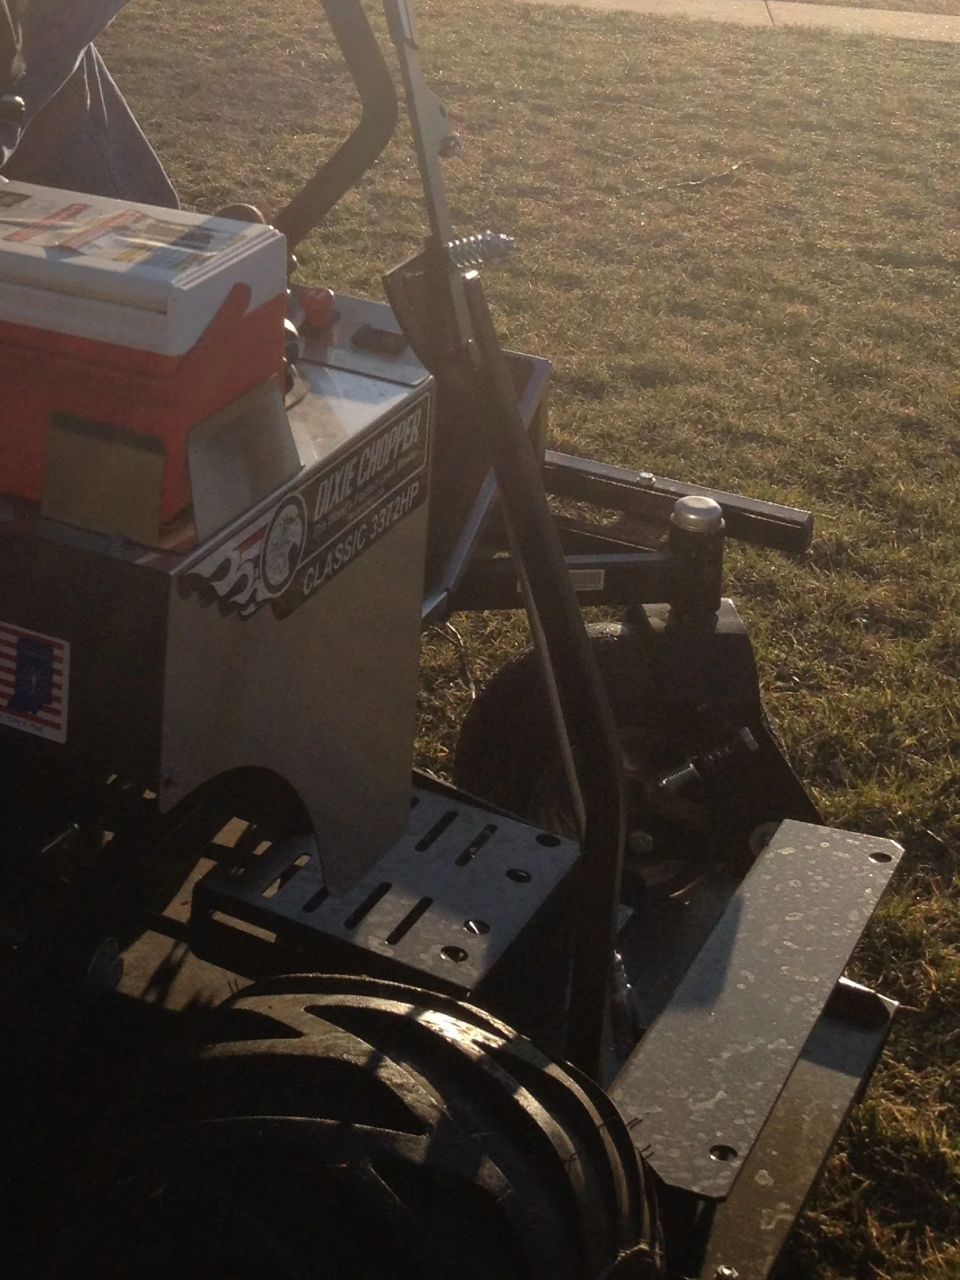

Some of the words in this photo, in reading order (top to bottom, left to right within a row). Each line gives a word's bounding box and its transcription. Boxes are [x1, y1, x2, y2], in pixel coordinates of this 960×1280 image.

[313, 461, 356, 520] DIXIE
[357, 407, 422, 485] CHOPPER
[302, 522, 368, 596] CLASSIC
